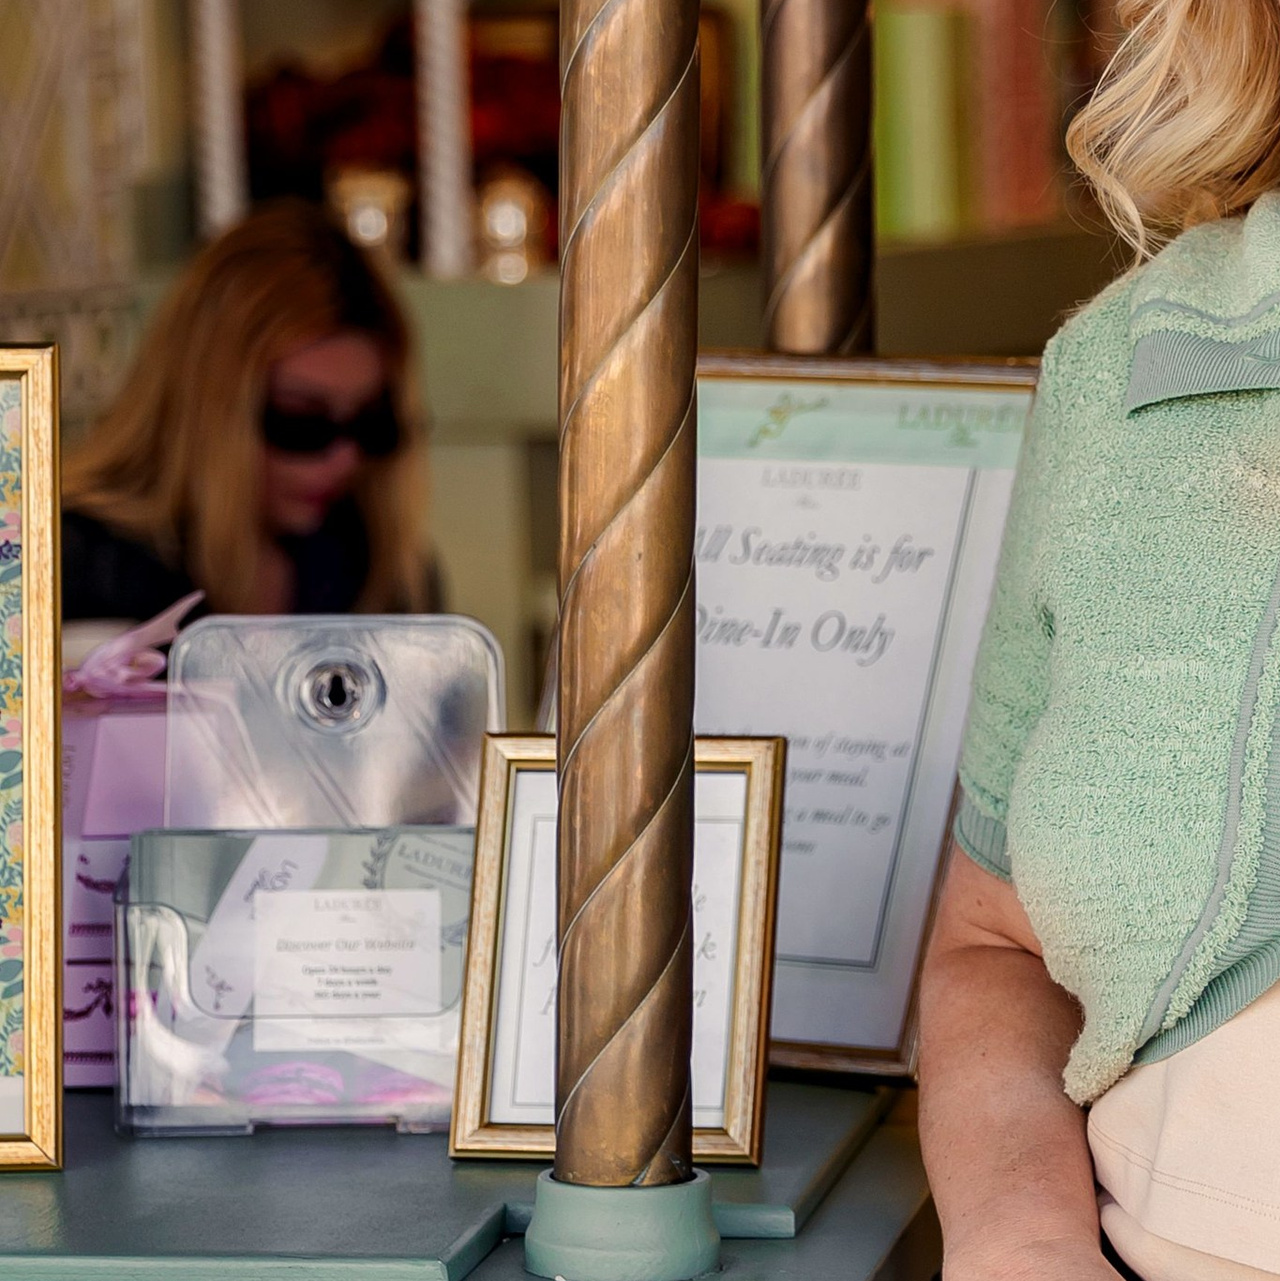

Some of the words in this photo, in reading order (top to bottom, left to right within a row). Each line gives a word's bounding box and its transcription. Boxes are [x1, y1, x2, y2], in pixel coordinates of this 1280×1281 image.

[728, 526, 846, 582] Seating
[849, 533, 881, 571] is
[871, 534, 935, 584] for
[810, 609, 896, 668] Only
